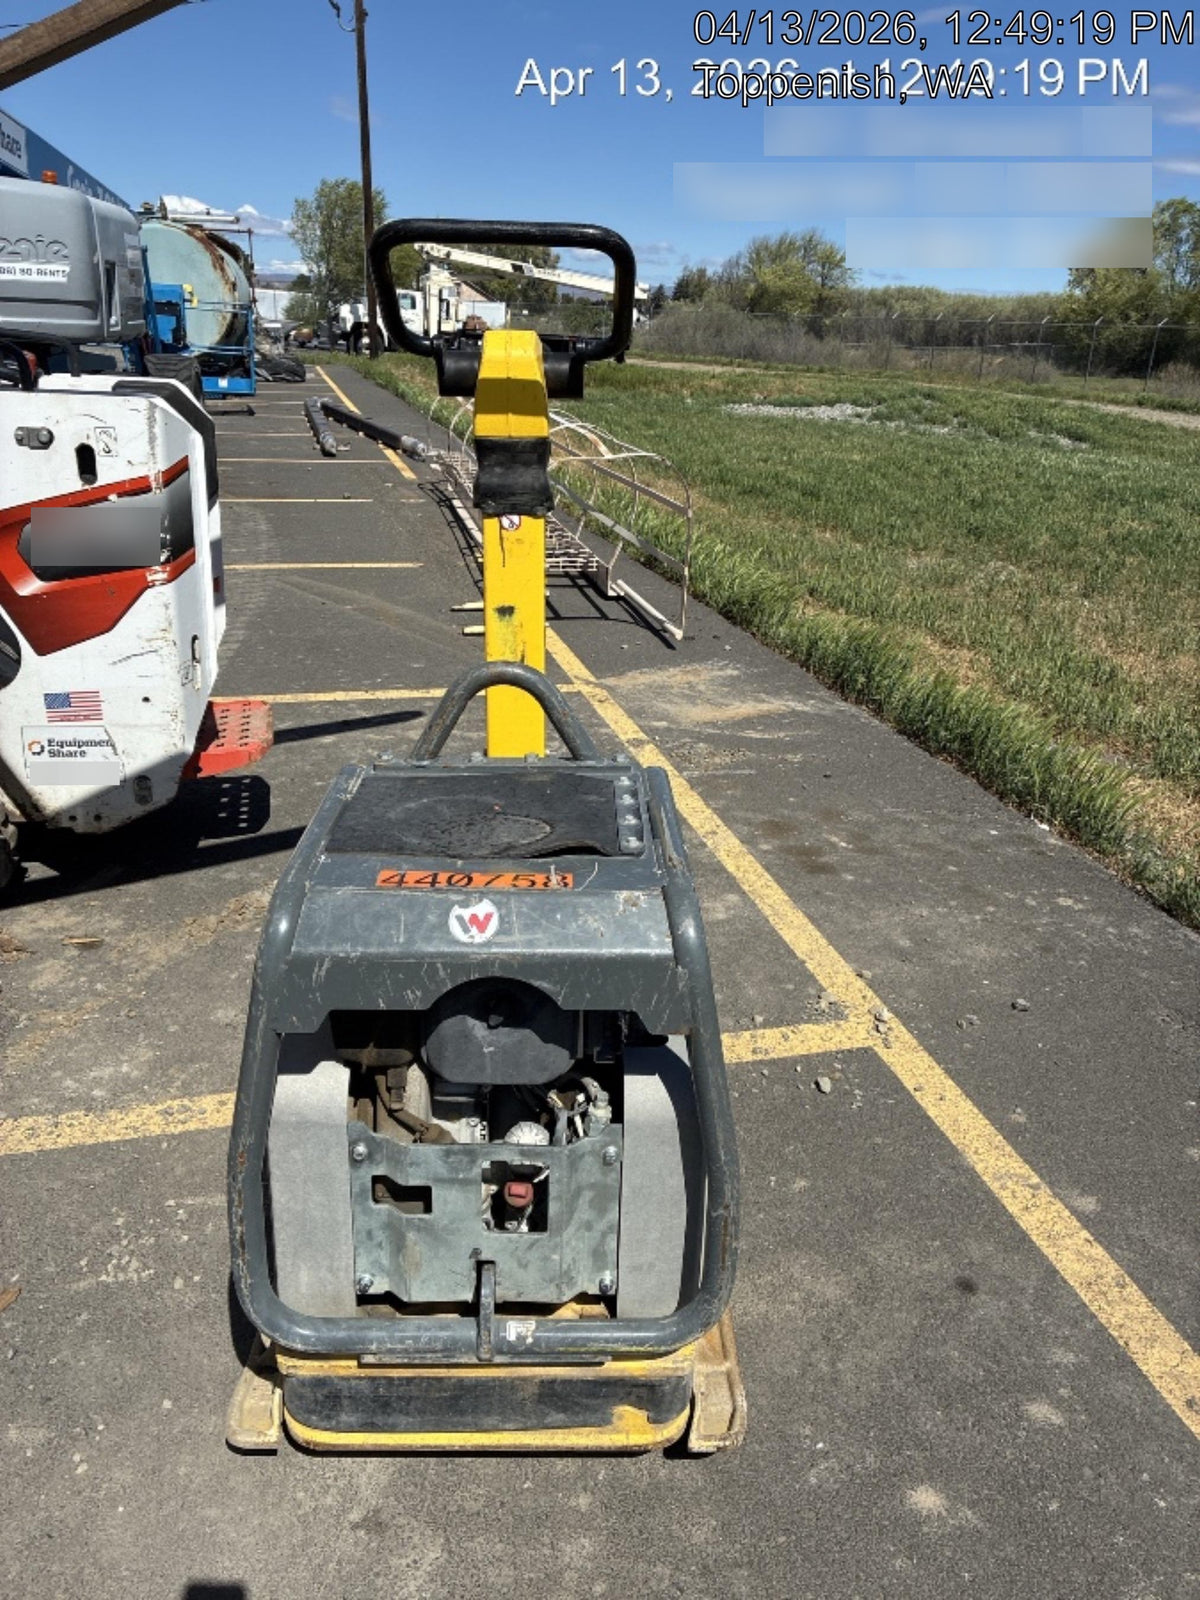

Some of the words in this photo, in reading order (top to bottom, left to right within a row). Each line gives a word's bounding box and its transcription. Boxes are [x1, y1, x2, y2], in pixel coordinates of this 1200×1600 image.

[0, 122, 22, 159] hare
[0, 234, 69, 262] enie
[47, 738, 113, 749] Equipmen
[47, 748, 86, 758] Share
